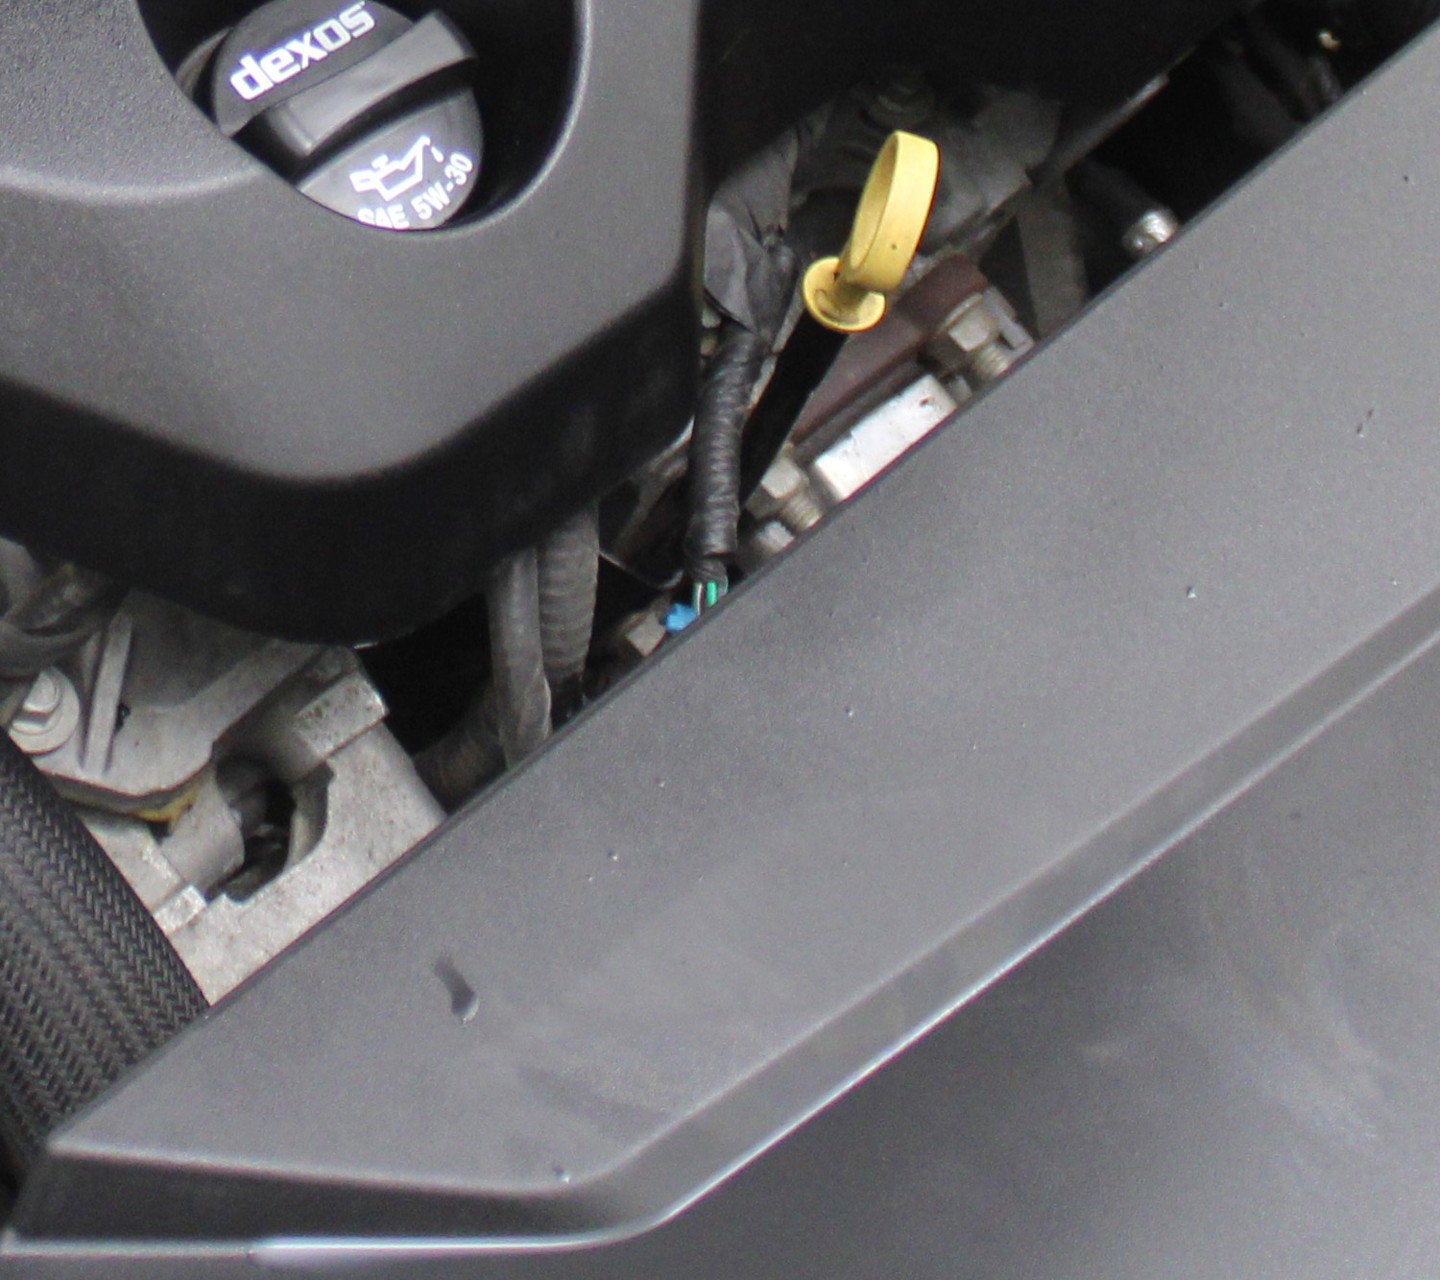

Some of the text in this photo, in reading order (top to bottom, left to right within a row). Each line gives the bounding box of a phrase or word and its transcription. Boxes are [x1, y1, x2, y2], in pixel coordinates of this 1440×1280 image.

[229, 1, 376, 101] dexos
[357, 152, 473, 230] SAE 5W-30
